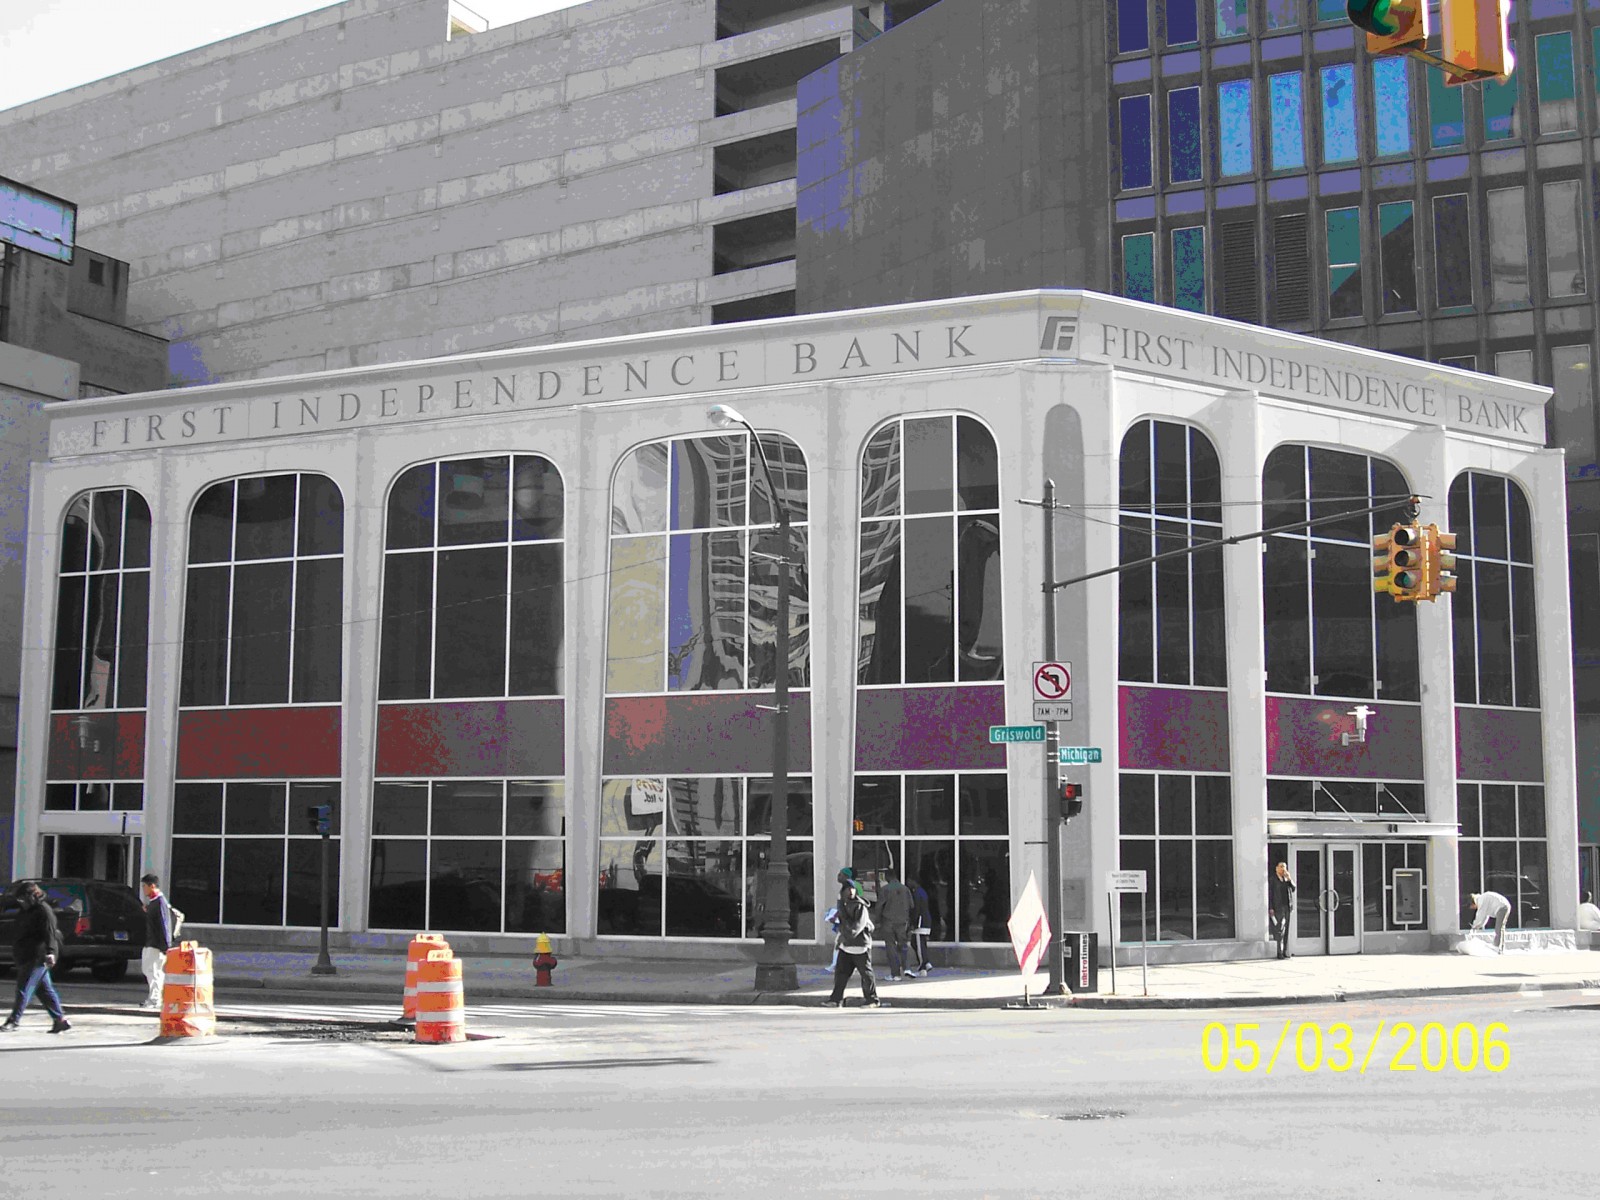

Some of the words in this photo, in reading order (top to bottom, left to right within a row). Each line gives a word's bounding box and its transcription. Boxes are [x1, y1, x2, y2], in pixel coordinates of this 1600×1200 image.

[93, 406, 232, 447] FIRST
[272, 350, 739, 429] INDEPENDENCE
[793, 325, 976, 374] BANK
[1101, 323, 1194, 371] FIRST
[1212, 346, 1436, 416] INDEPENDENCE
[1457, 395, 1529, 433] BANK
[994, 728, 1041, 741] Griswold
[1061, 748, 1099, 761] Michigan
